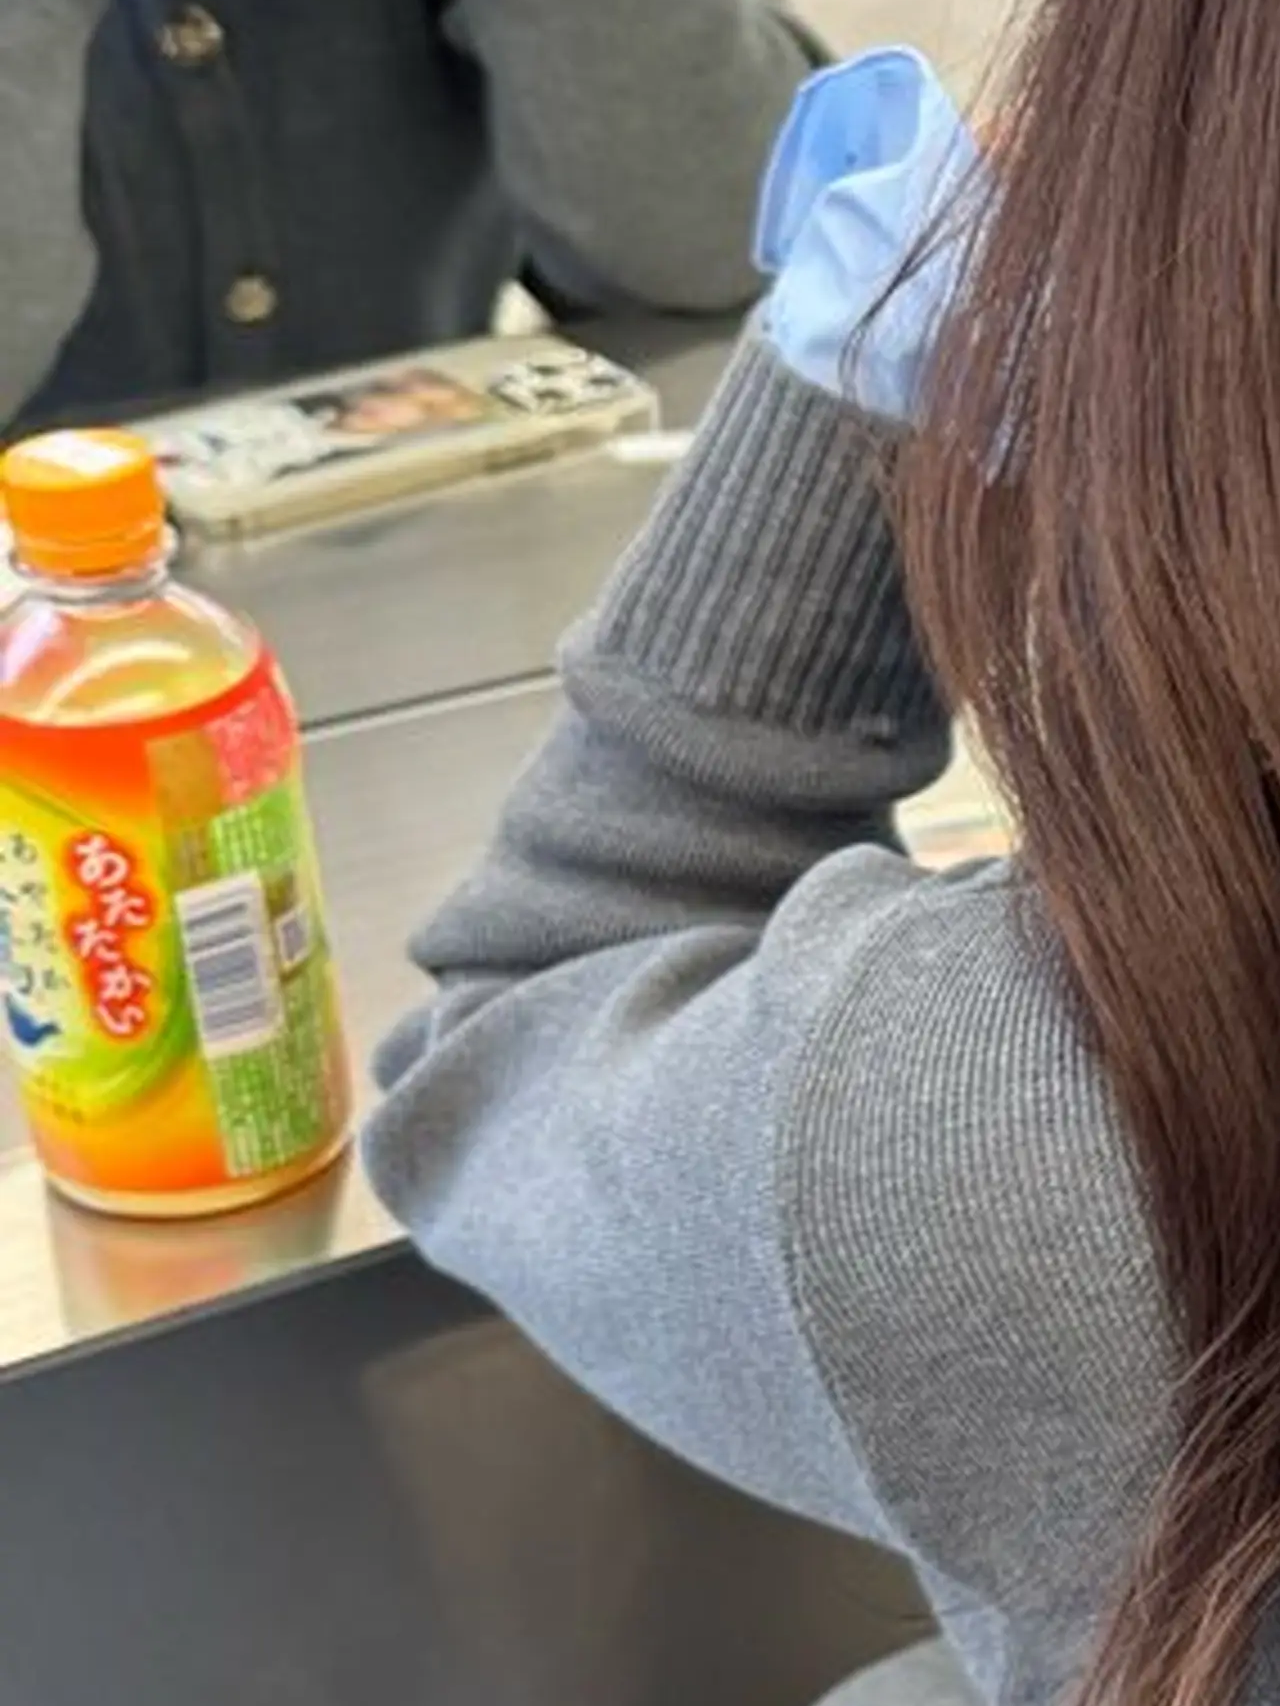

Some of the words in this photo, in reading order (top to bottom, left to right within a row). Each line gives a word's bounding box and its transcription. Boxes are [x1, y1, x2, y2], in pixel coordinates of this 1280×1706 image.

[73, 833, 151, 1035] あたたかい
